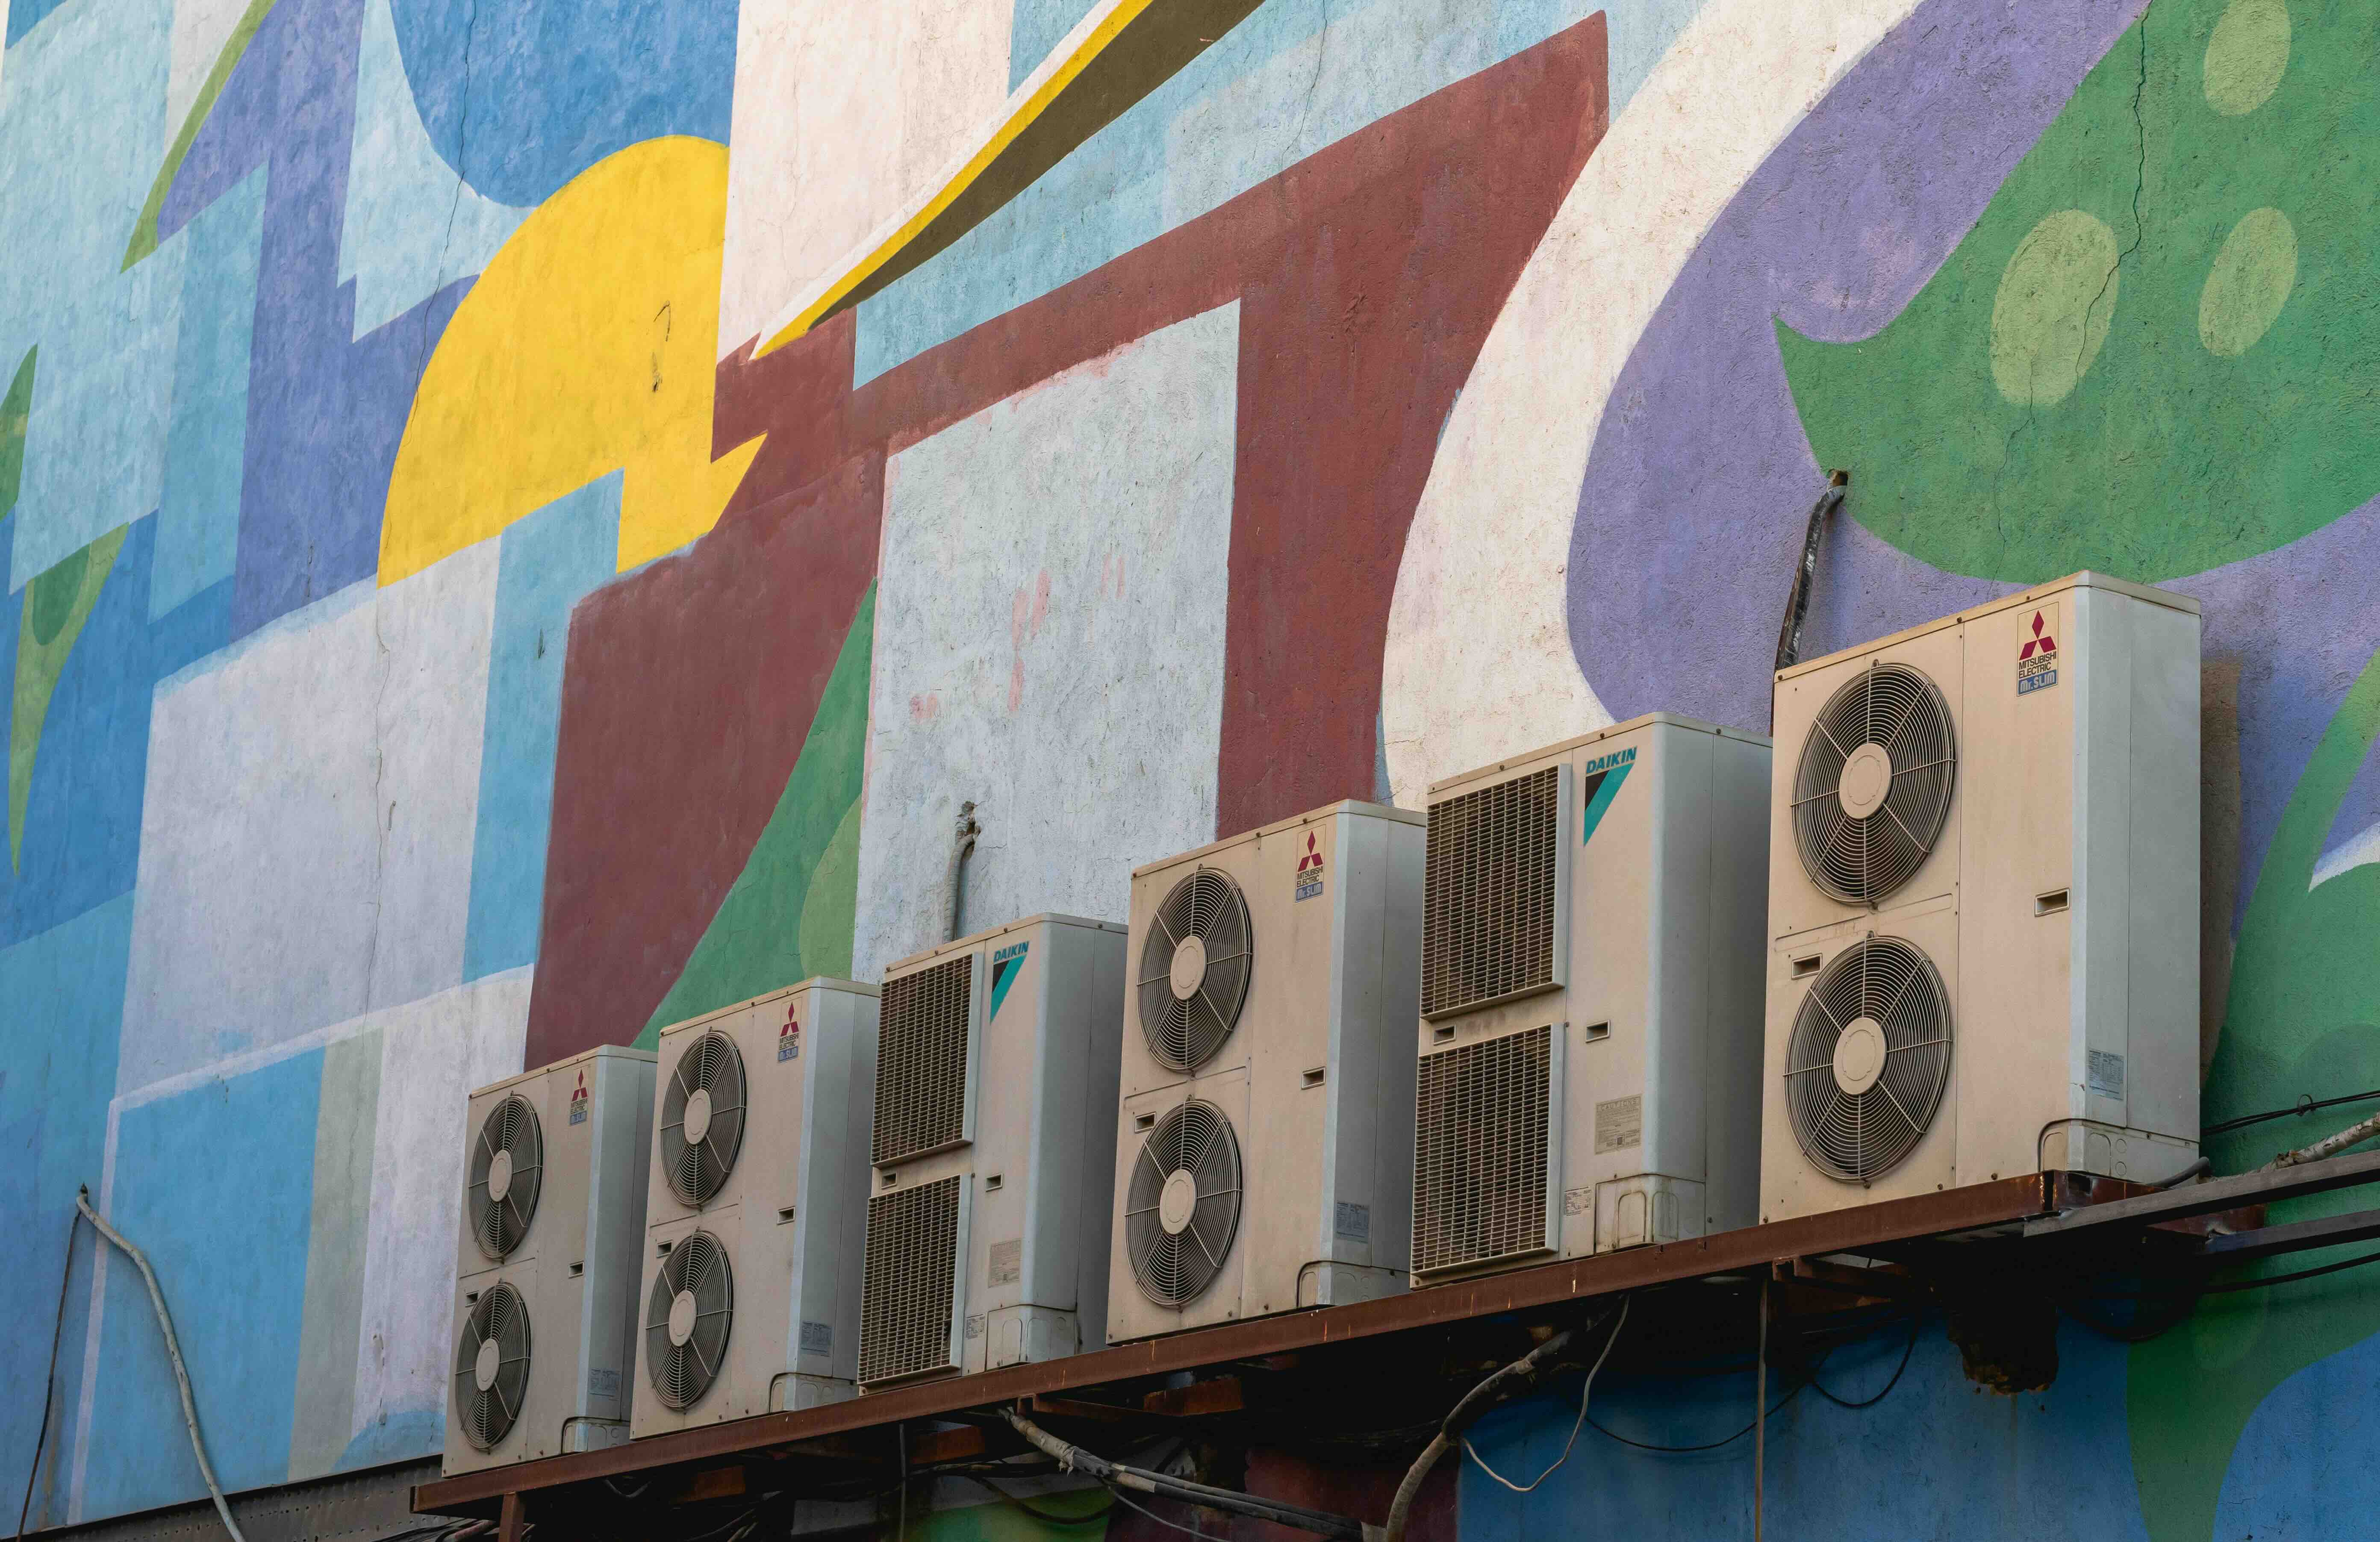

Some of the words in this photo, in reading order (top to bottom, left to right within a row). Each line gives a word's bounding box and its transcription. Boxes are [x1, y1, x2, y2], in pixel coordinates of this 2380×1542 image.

[2018, 651, 2056, 670] MITSUBISHI
[2018, 662, 2051, 679] ELECTRIC
[1586, 746, 1637, 774] DAIKIN
[1297, 866, 1323, 880] MITSUBISHI
[1297, 875, 1319, 887] ELECTRIC
[993, 941, 1029, 962] DAIKIN
